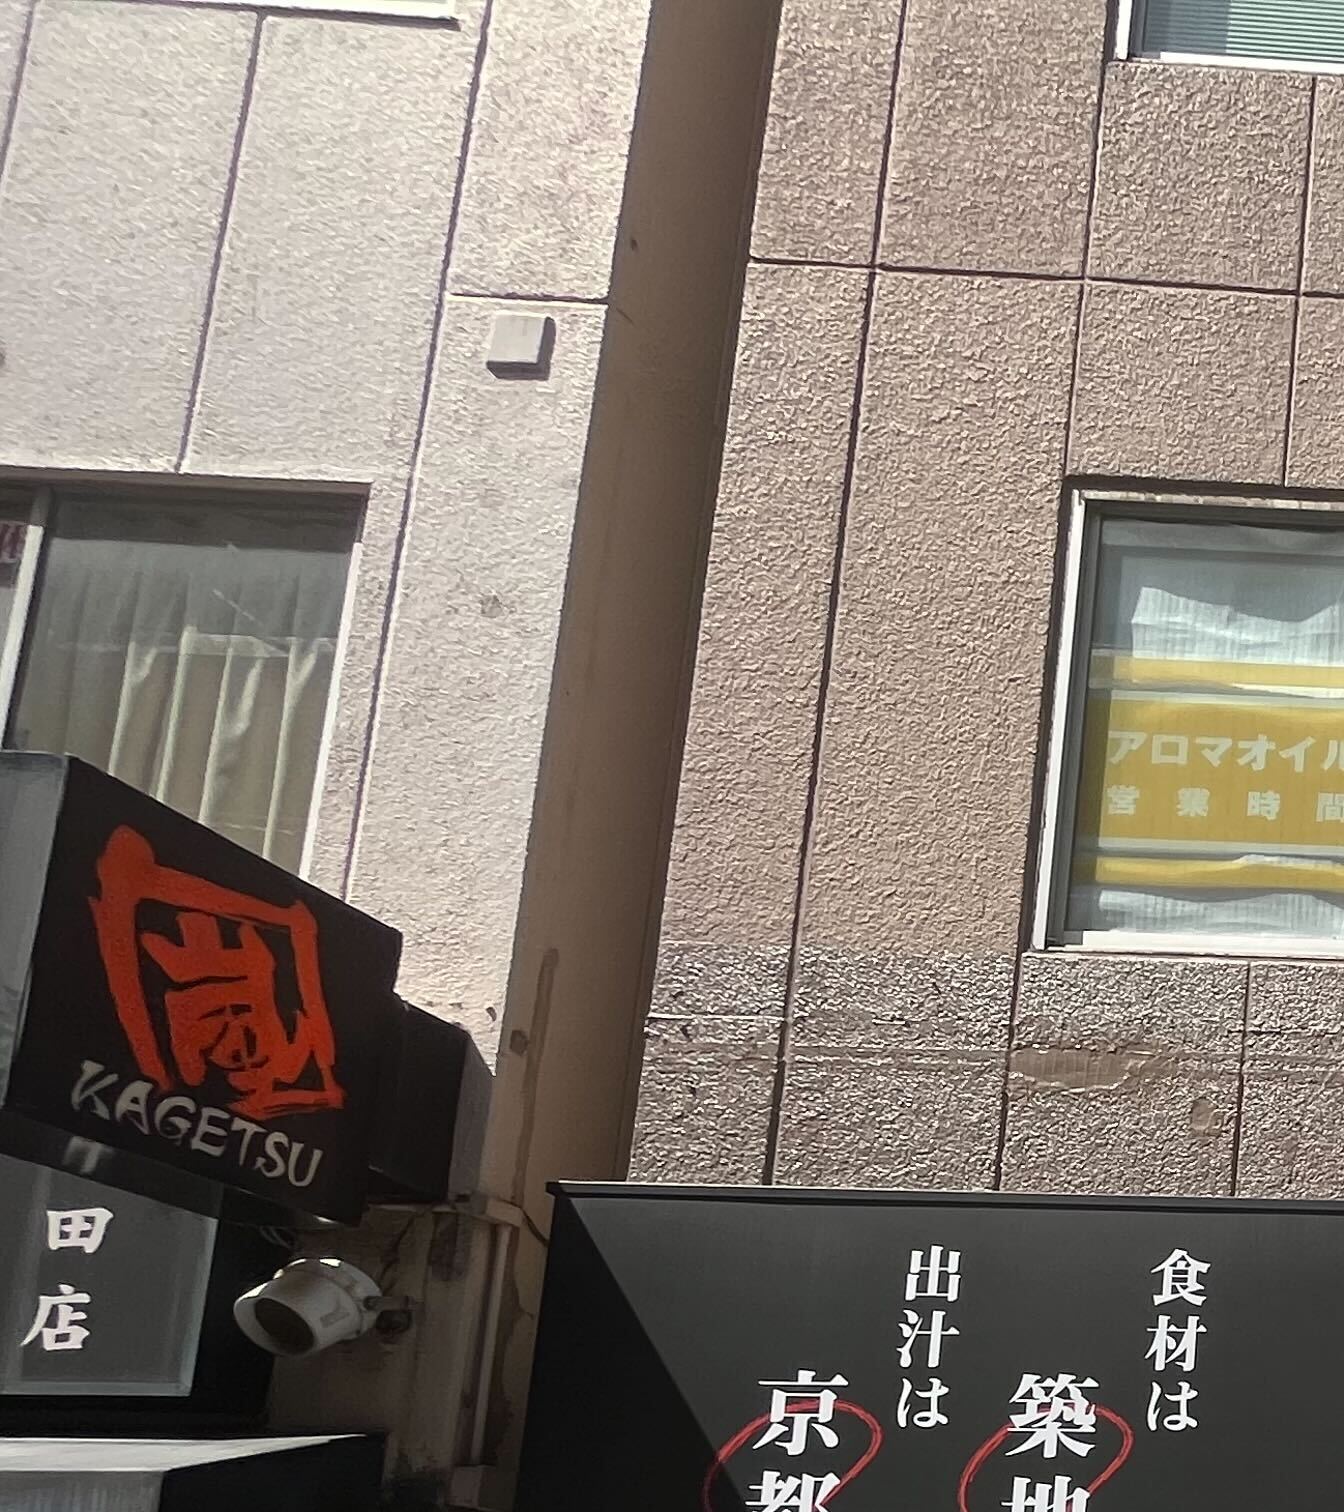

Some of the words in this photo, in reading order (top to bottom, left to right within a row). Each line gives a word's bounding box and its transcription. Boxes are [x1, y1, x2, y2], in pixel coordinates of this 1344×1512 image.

[71, 1058, 324, 1188] KAGETSU
[896, 1244, 961, 1429] 出汁は
[1144, 1247, 1212, 1433] 食材は
